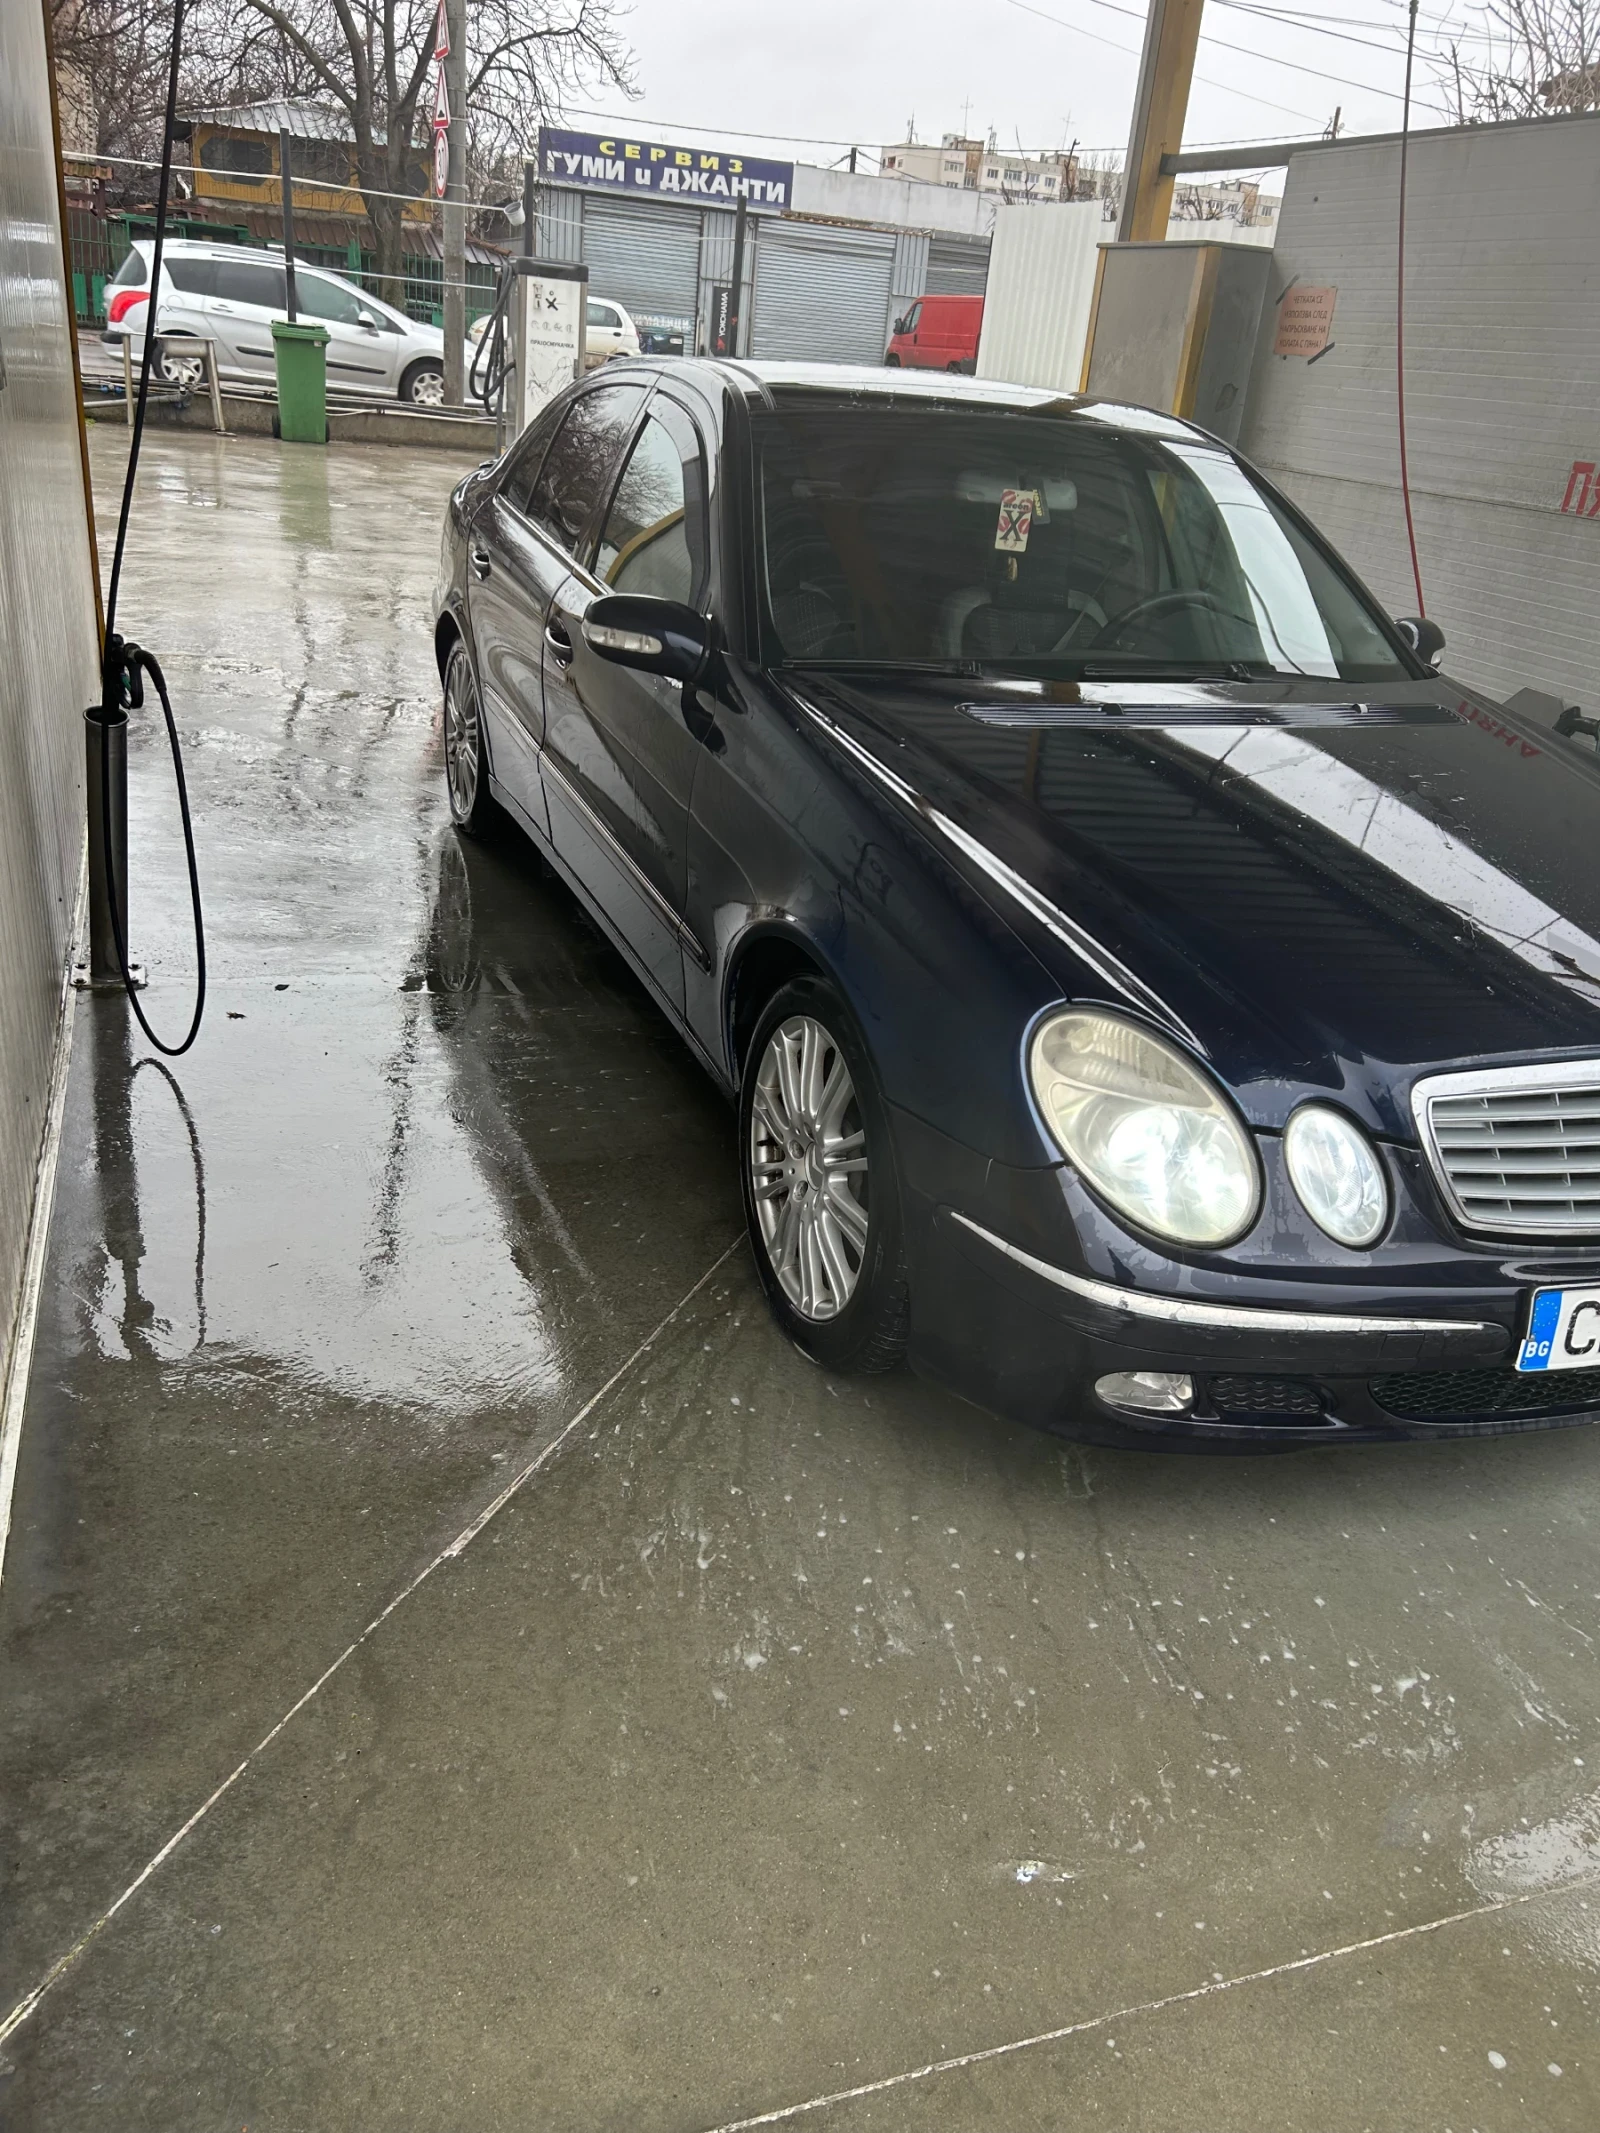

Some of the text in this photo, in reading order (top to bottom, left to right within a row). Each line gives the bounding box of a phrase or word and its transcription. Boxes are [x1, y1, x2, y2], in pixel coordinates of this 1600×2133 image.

[599, 141, 743, 173] СЕРВИЗ
[547, 150, 785, 204] ГУМИ и ДЖАНТИ
[718, 291, 729, 337] YOKOHAMA
[1003, 503, 1029, 511] areon
[999, 509, 1027, 541] X
[1525, 1340, 1550, 1358] BG
